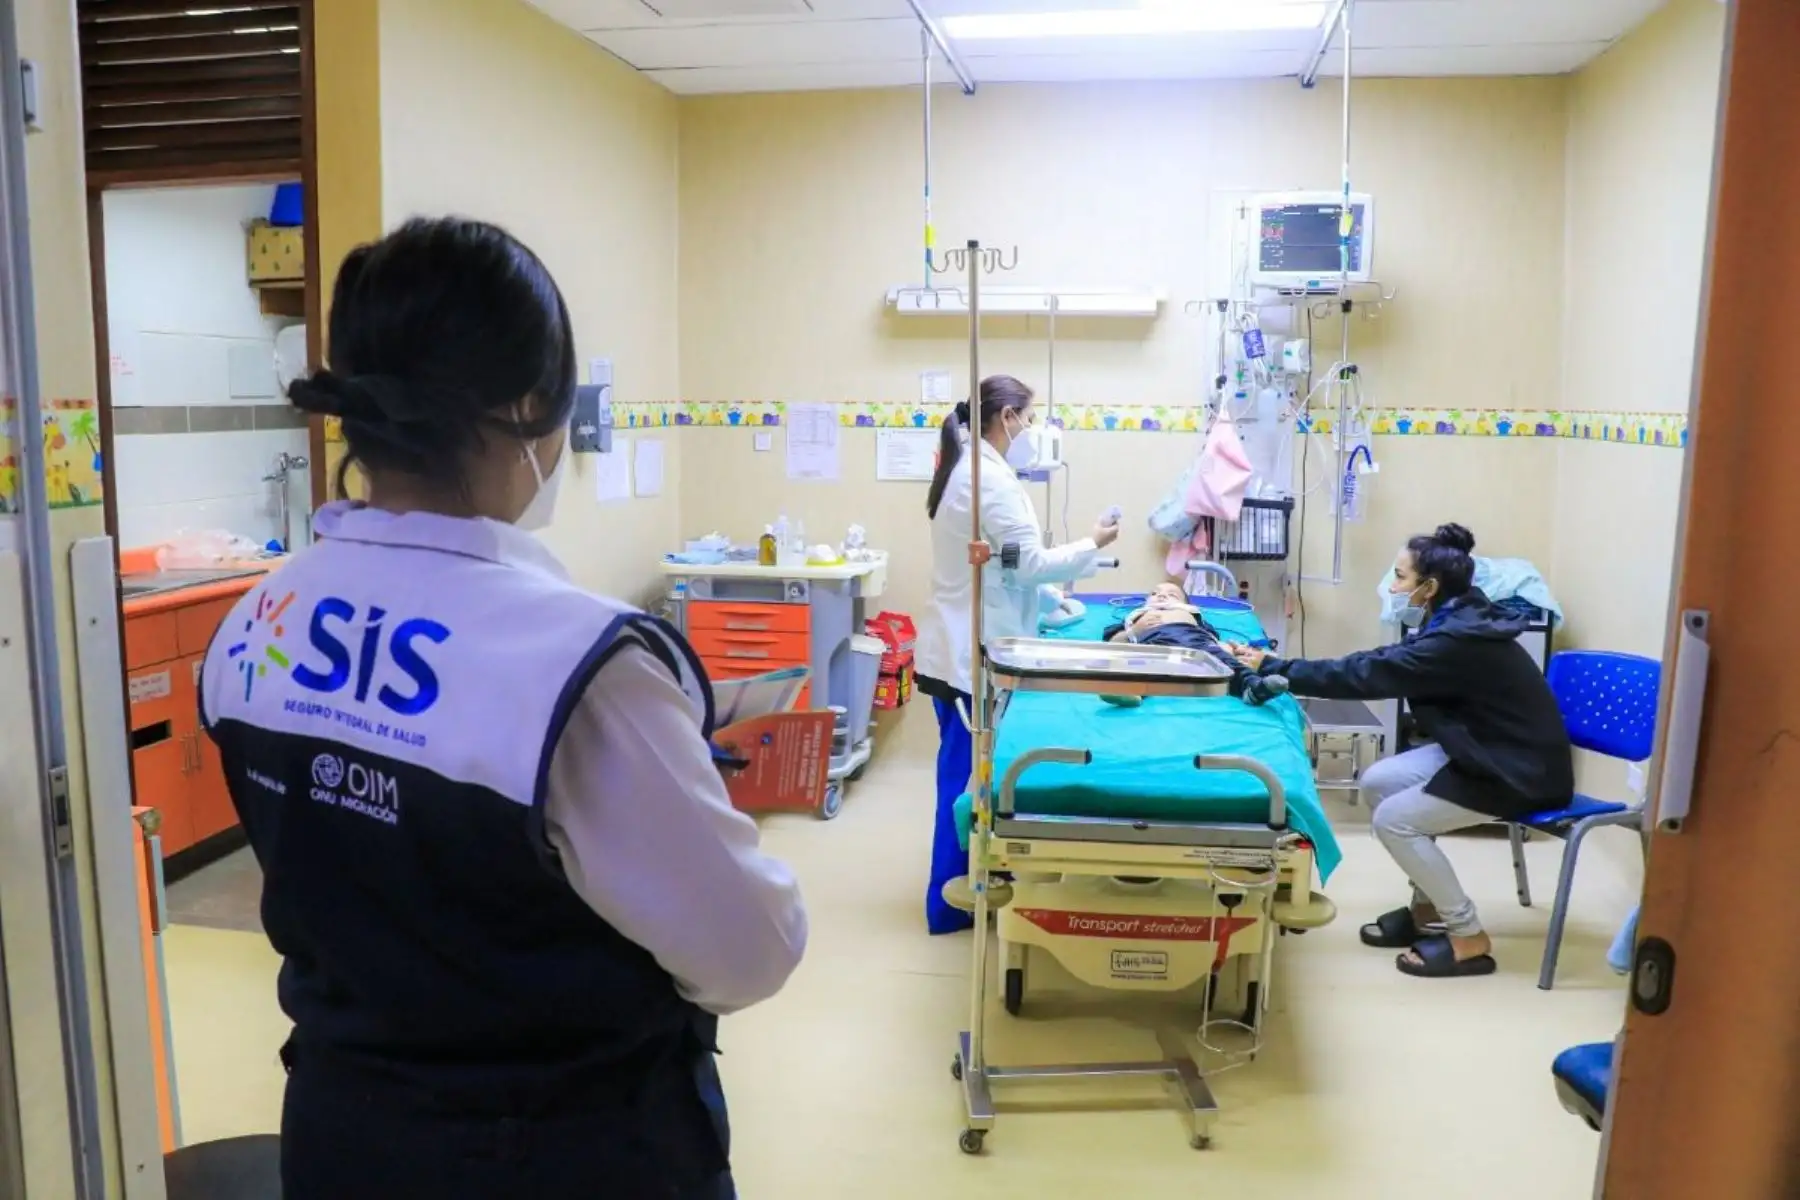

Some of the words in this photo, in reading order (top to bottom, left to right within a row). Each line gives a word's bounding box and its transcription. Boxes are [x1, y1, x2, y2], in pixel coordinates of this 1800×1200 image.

[284, 699, 332, 719] SEGURO
[376, 722, 390, 737] DE
[393, 728, 427, 747] SALUD
[310, 787, 337, 805] ONU
[348, 763, 399, 810] OIM
[1068, 914, 1140, 932] Transport
[1143, 921, 1204, 934] stretcher
